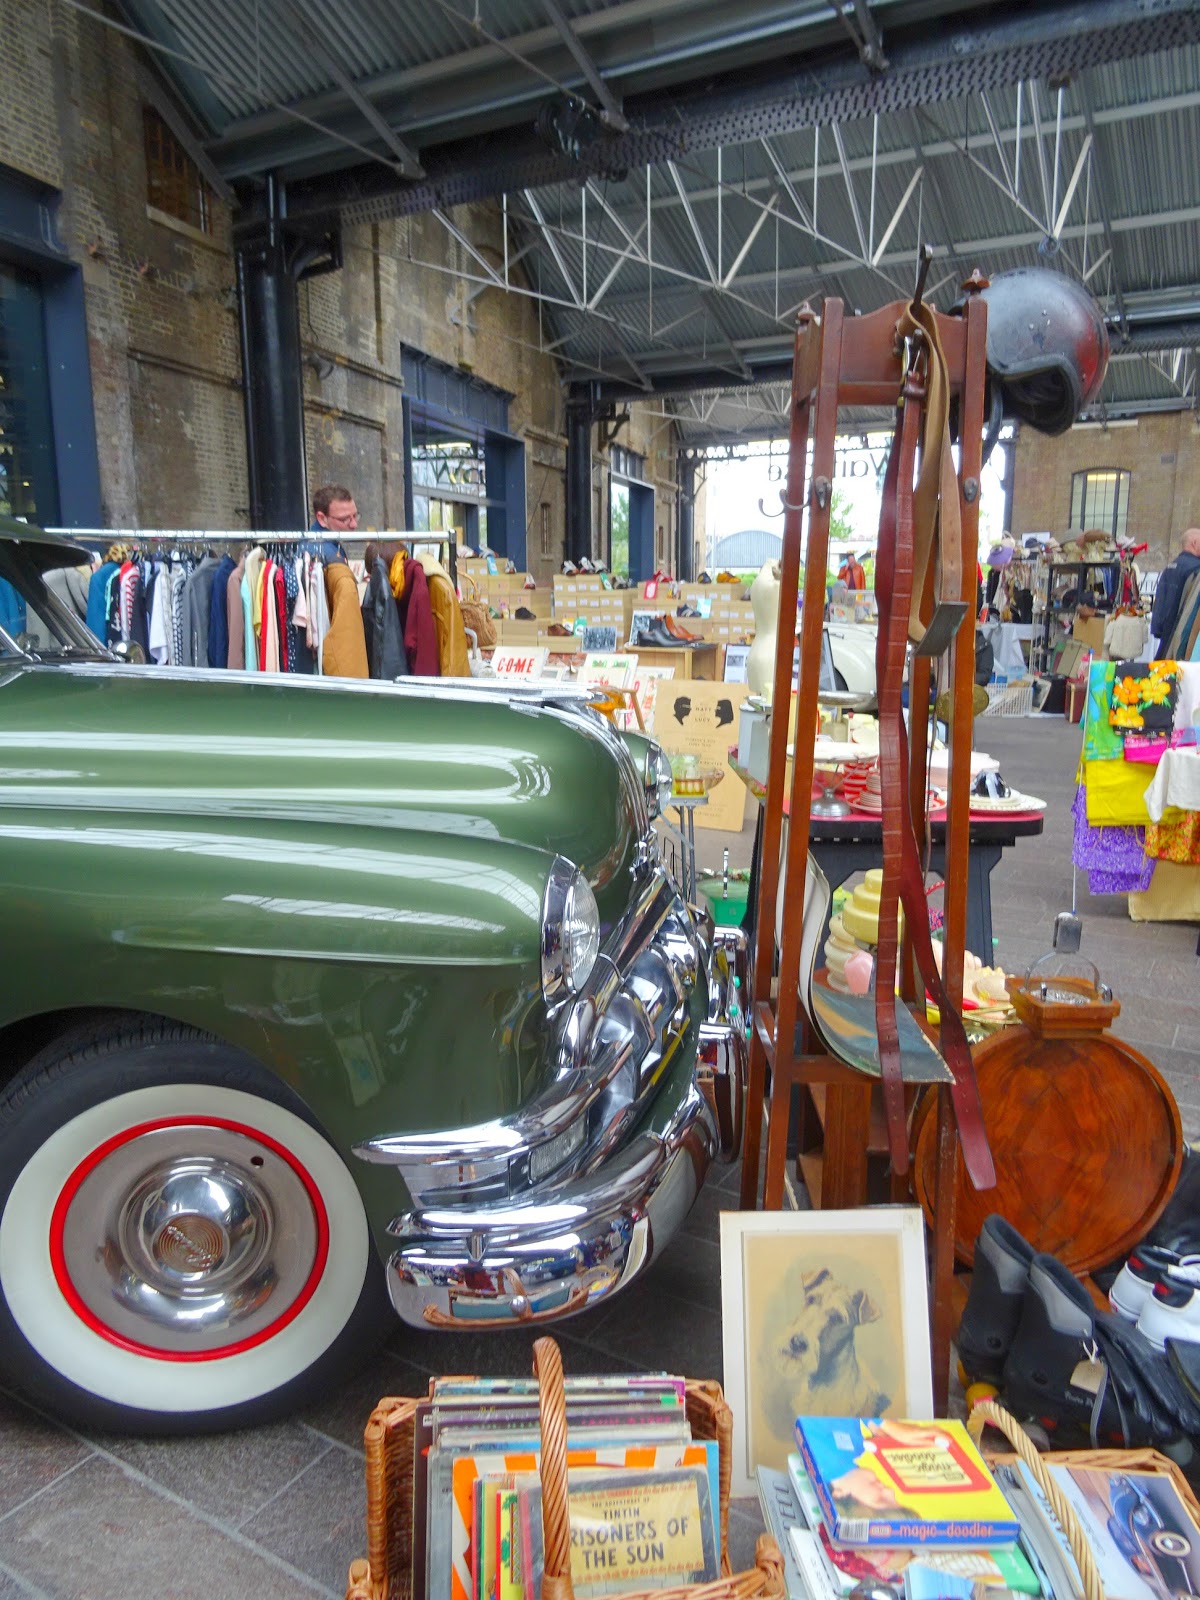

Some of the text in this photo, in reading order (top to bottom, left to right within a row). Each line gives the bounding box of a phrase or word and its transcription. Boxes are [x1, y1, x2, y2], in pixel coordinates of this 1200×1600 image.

[497, 657, 535, 674] COME
[603, 1507, 640, 1520] TINTIN
[570, 1516, 689, 1547] RISONERS OF
[899, 1524, 937, 1541] magic
[946, 1522, 994, 1538] doodler
[582, 1541, 665, 1569] THE SUN
